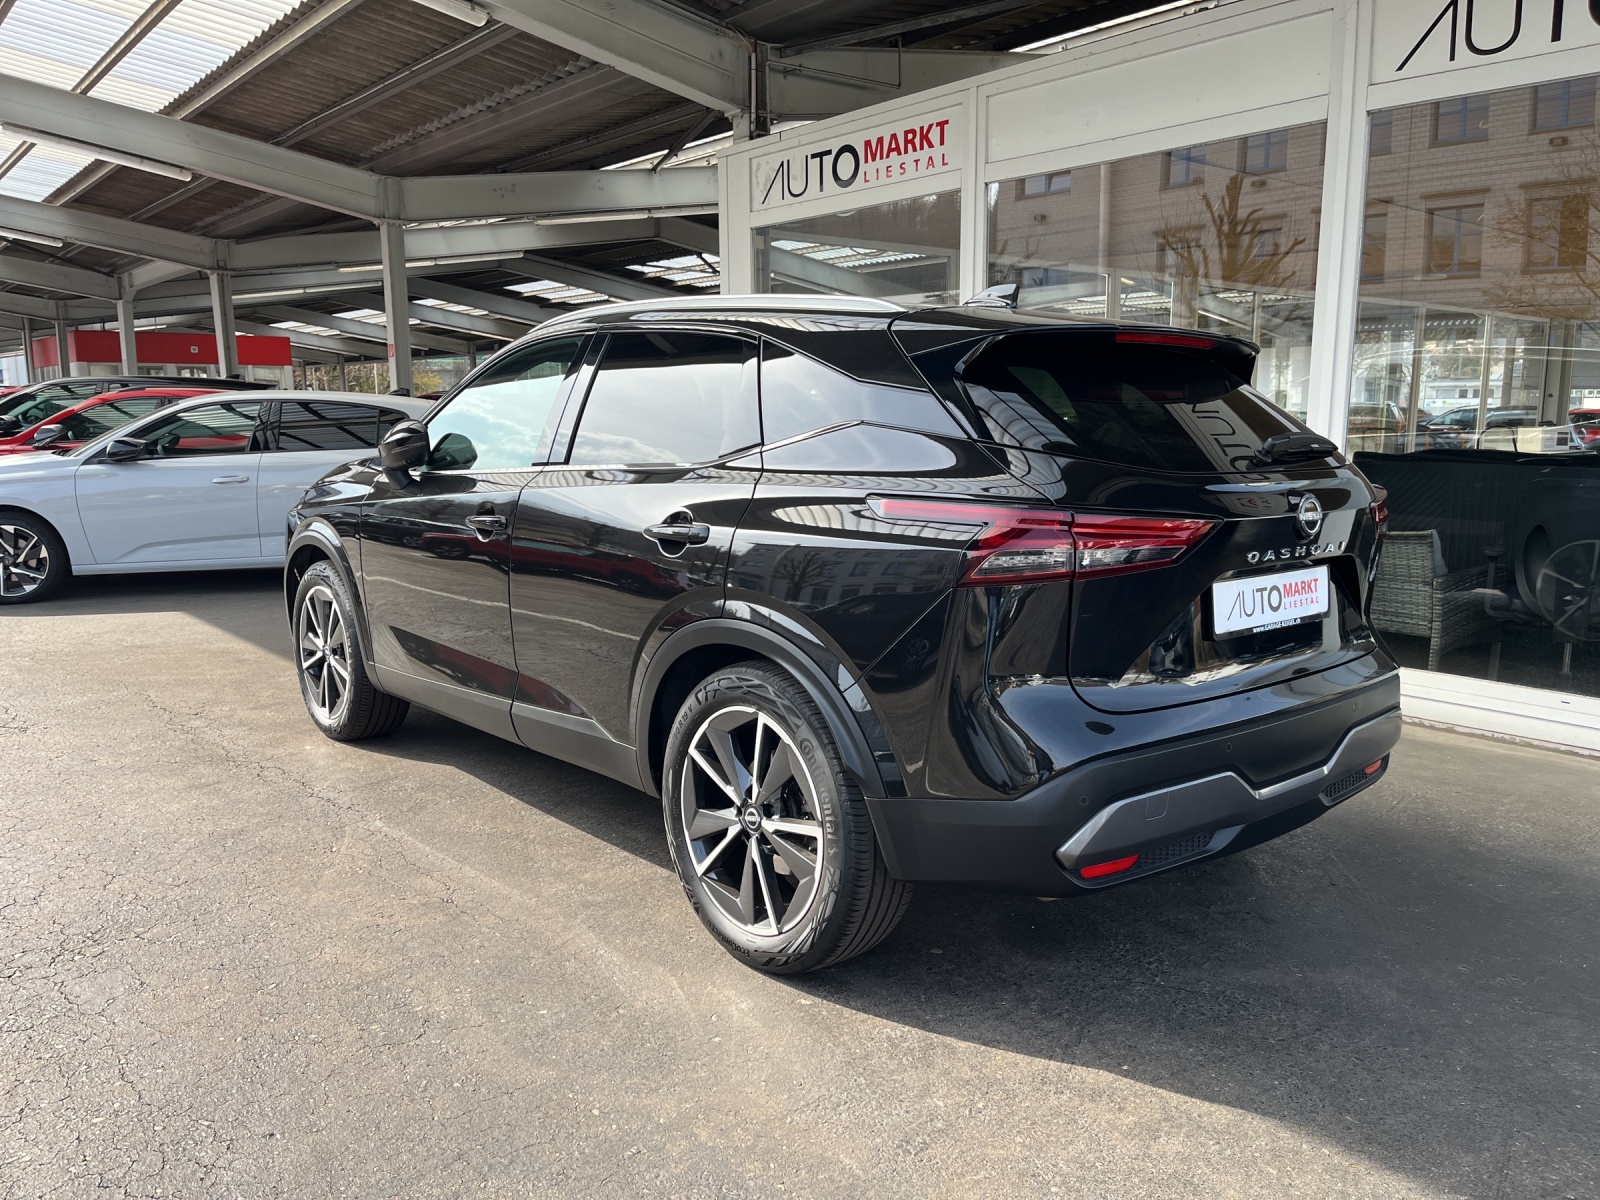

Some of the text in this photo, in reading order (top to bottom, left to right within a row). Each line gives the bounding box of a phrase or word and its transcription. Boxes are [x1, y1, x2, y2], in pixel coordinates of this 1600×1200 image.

[1395, 0, 1600, 72] AU
[762, 119, 949, 204] AUTO MARKT
[864, 153, 948, 183] LIESTAL
[1246, 541, 1345, 564] QASHQAI
[1227, 578, 1318, 621] AUTO MARKT
[1284, 596, 1319, 610] LIESTAL
[800, 738, 838, 840] Continental
